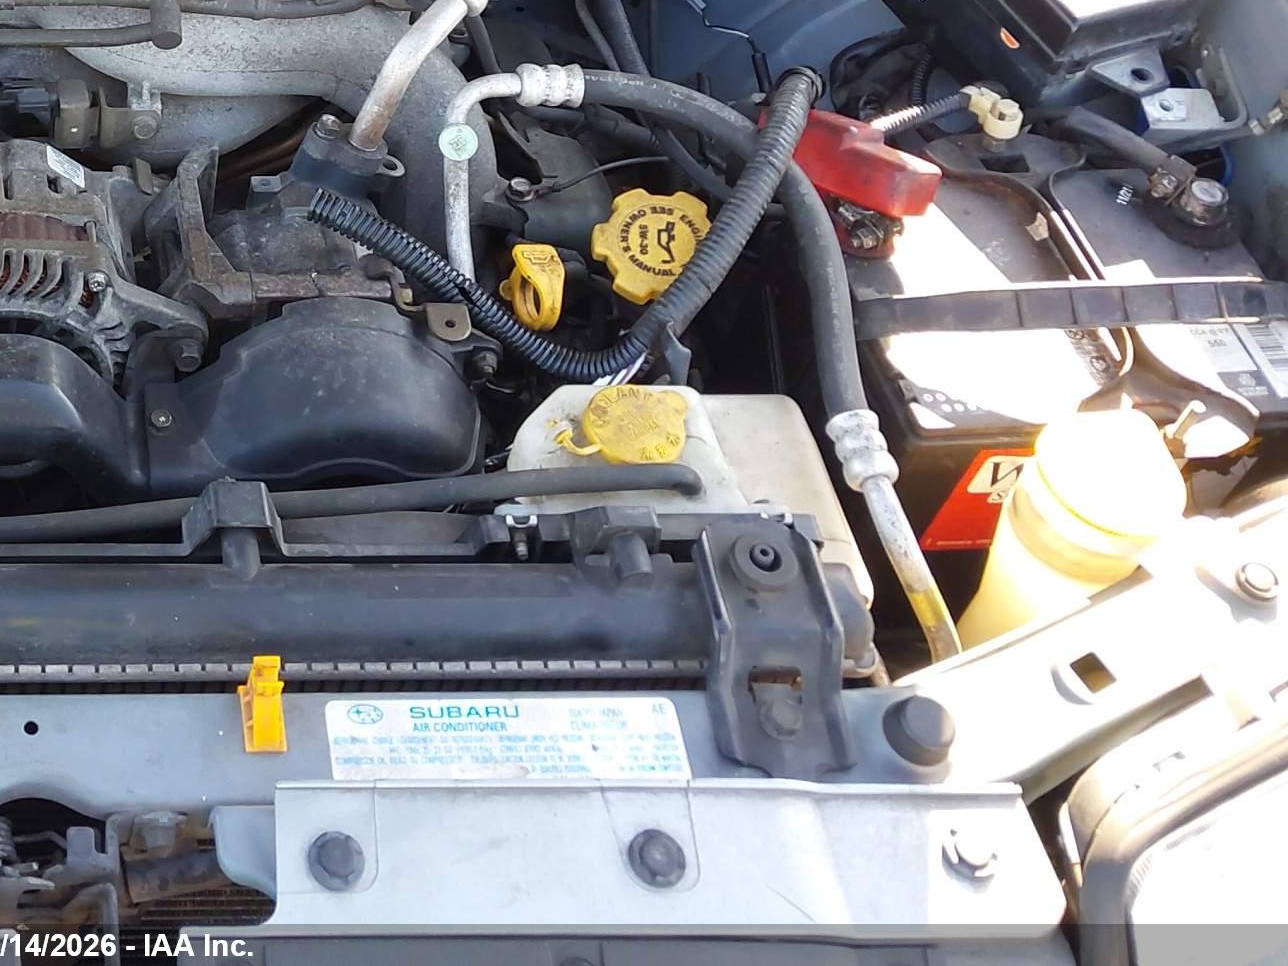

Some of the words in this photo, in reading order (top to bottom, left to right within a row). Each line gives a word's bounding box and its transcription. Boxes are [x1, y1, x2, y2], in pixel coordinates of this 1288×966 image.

[649, 206, 674, 215] SEE
[638, 224, 649, 256] 5W-30
[628, 254, 676, 276] MANUAL
[410, 705, 520, 719] SUBARU
[412, 722, 432, 733] AIR
[434, 720, 508, 733] CONDITIONER
